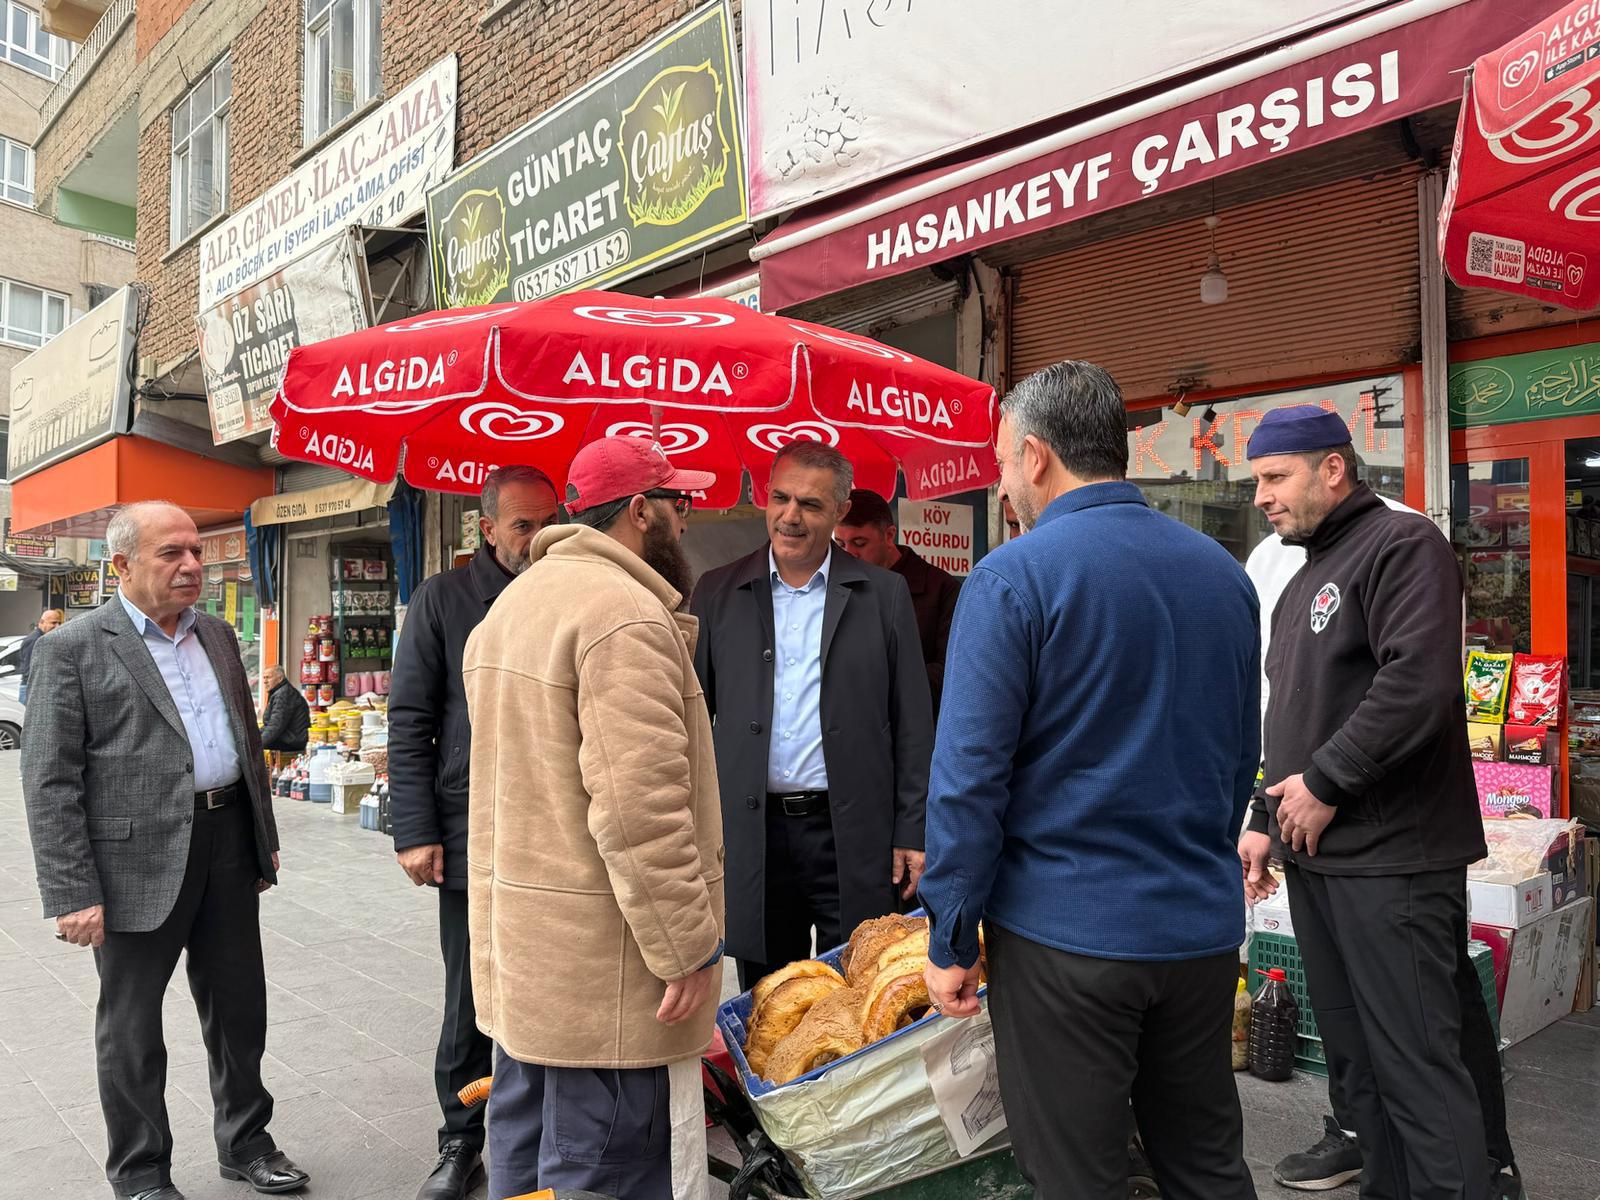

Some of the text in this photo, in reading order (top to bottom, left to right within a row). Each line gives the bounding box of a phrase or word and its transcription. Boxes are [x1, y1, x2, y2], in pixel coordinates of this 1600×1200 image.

[507, 118, 613, 207] GÜNTAÇ
[630, 113, 714, 191] Çaytaş
[866, 49, 1399, 270] HASANKEYF ÇARŞISI
[243, 181, 305, 251] GENEL
[388, 189, 405, 217] 10
[510, 180, 621, 266] TİCARET
[216, 271, 233, 296] ALO
[267, 239, 282, 264] EV
[284, 209, 320, 255] İŞYERİ
[447, 228, 500, 286] Çaytaş
[517, 268, 550, 302] 0537
[554, 255, 579, 288] 587
[584, 245, 601, 274] 11
[605, 235, 625, 266] 52
[232, 285, 293, 345] ÖZ SARI
[239, 331, 295, 380] TİCARET
[276, 503, 291, 518] ÖZEN
[291, 502, 307, 517] GIDA
[903, 528, 969, 550] YOĞURDU
[923, 505, 951, 525] KÖY
[68, 570, 98, 582] NOVA
